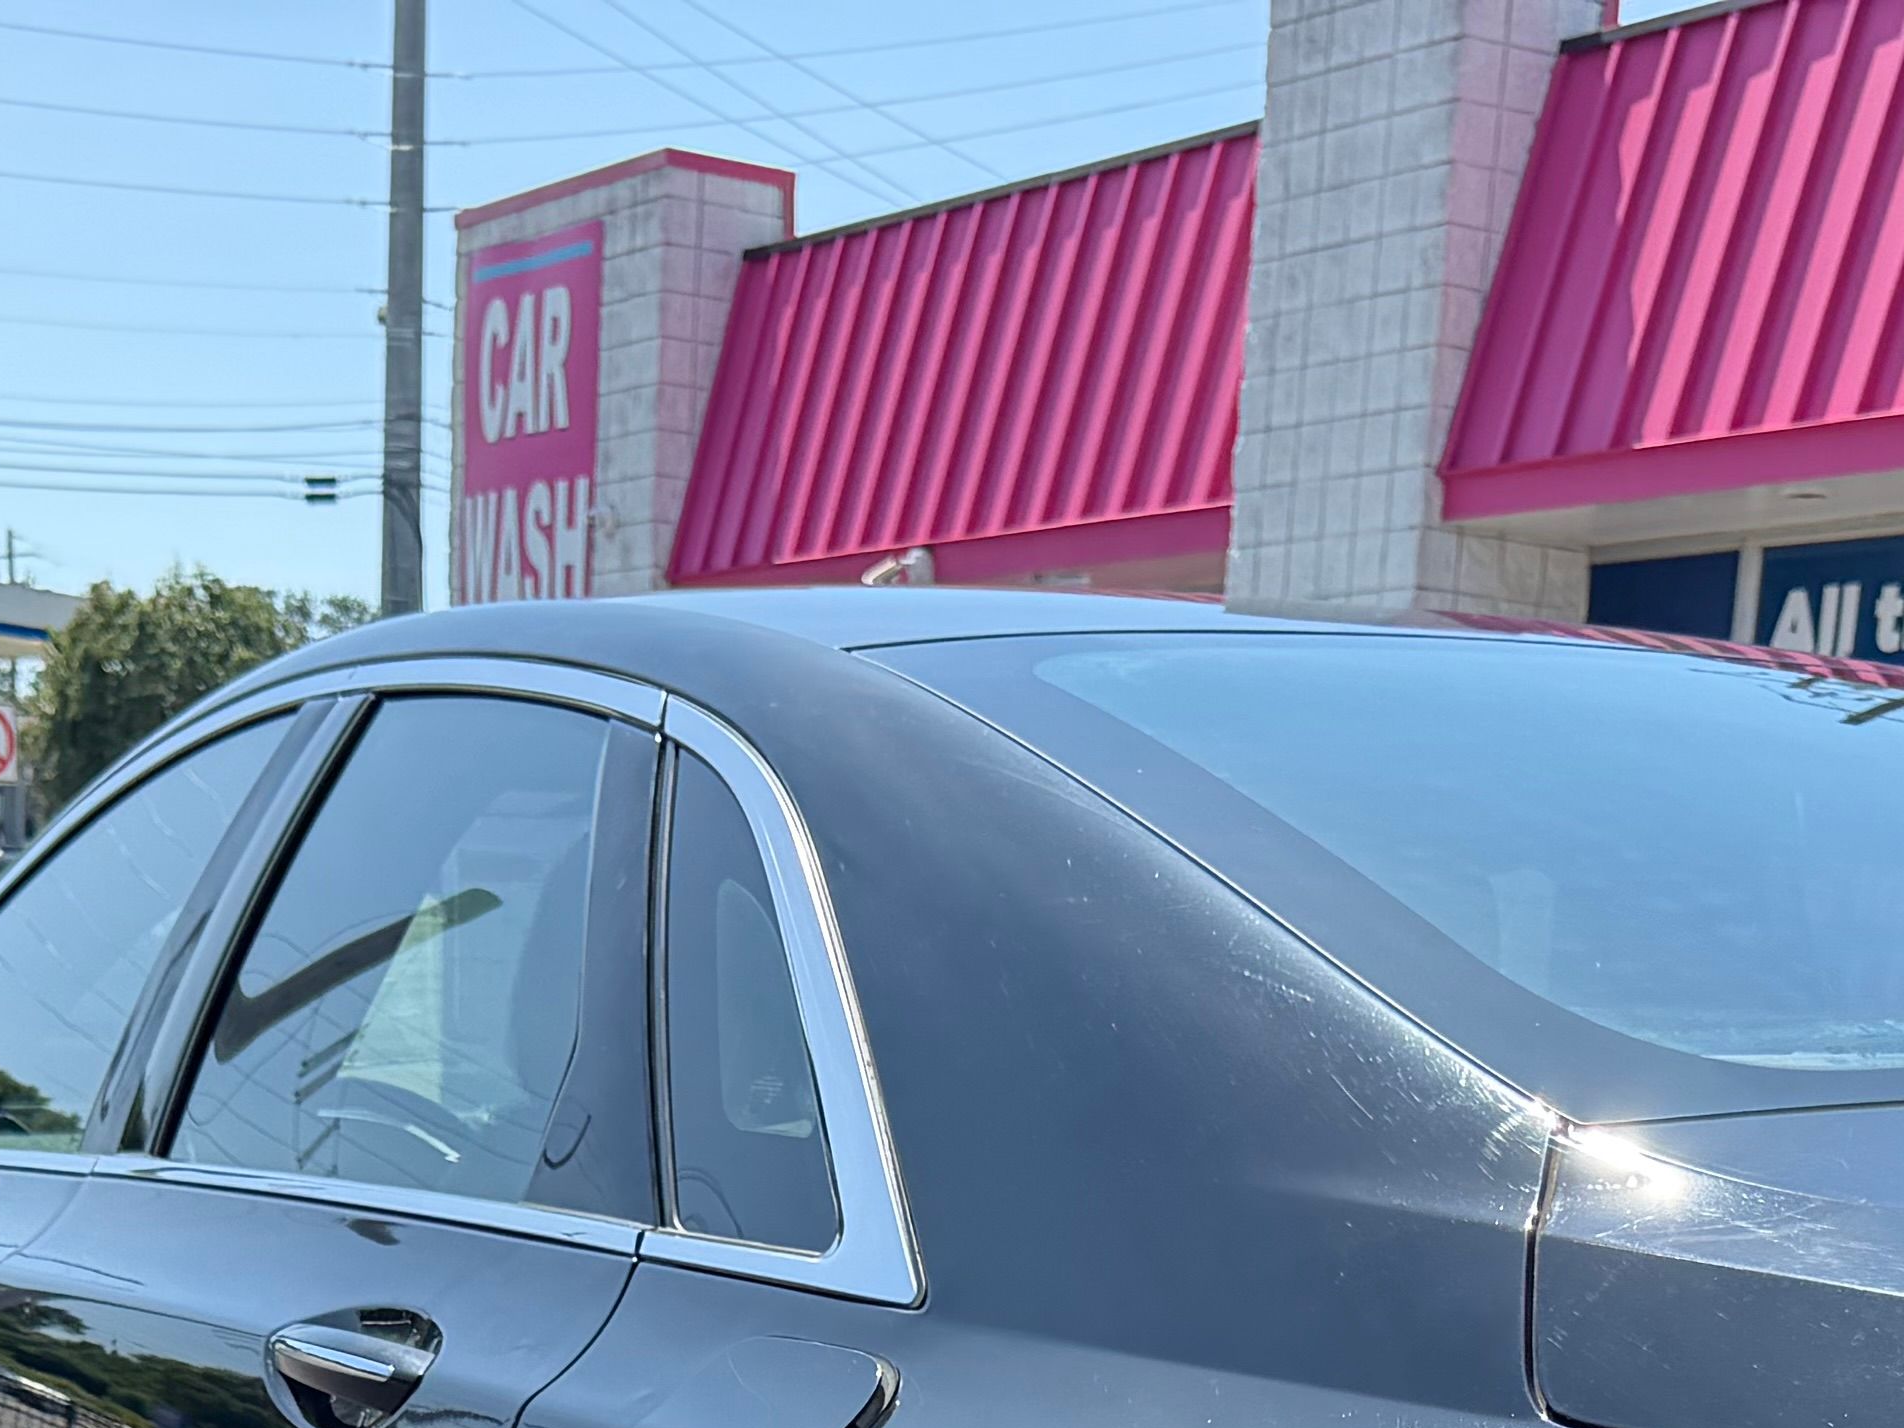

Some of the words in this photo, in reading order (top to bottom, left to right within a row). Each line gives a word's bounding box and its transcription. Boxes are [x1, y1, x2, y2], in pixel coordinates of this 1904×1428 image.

[478, 285, 571, 444] CAR
[464, 475, 592, 604] WASH
[1770, 581, 1863, 657] All
